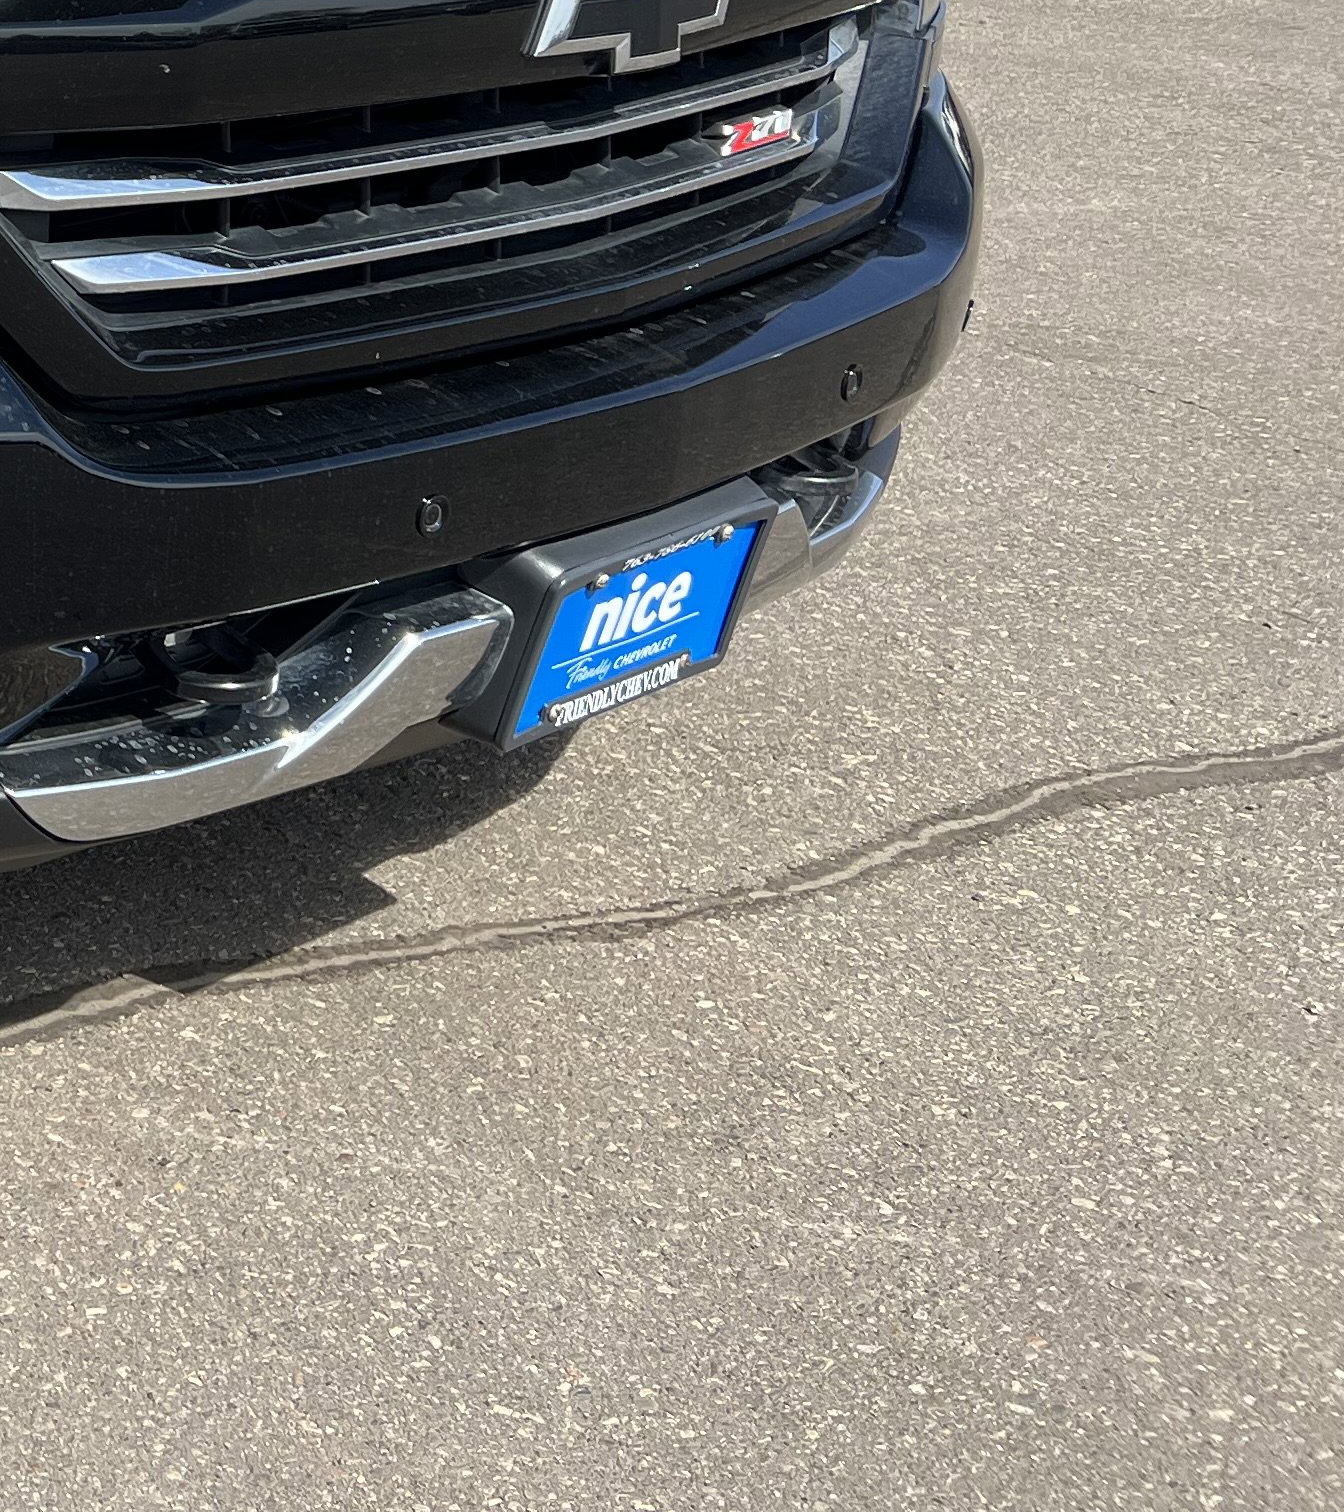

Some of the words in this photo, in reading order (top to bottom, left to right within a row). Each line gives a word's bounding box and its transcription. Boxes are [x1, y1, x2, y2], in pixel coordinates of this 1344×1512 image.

[720, 108, 793, 157] Z71
[579, 571, 692, 653] nice
[565, 657, 612, 690] Friendly
[613, 633, 678, 670] CHEVROLET
